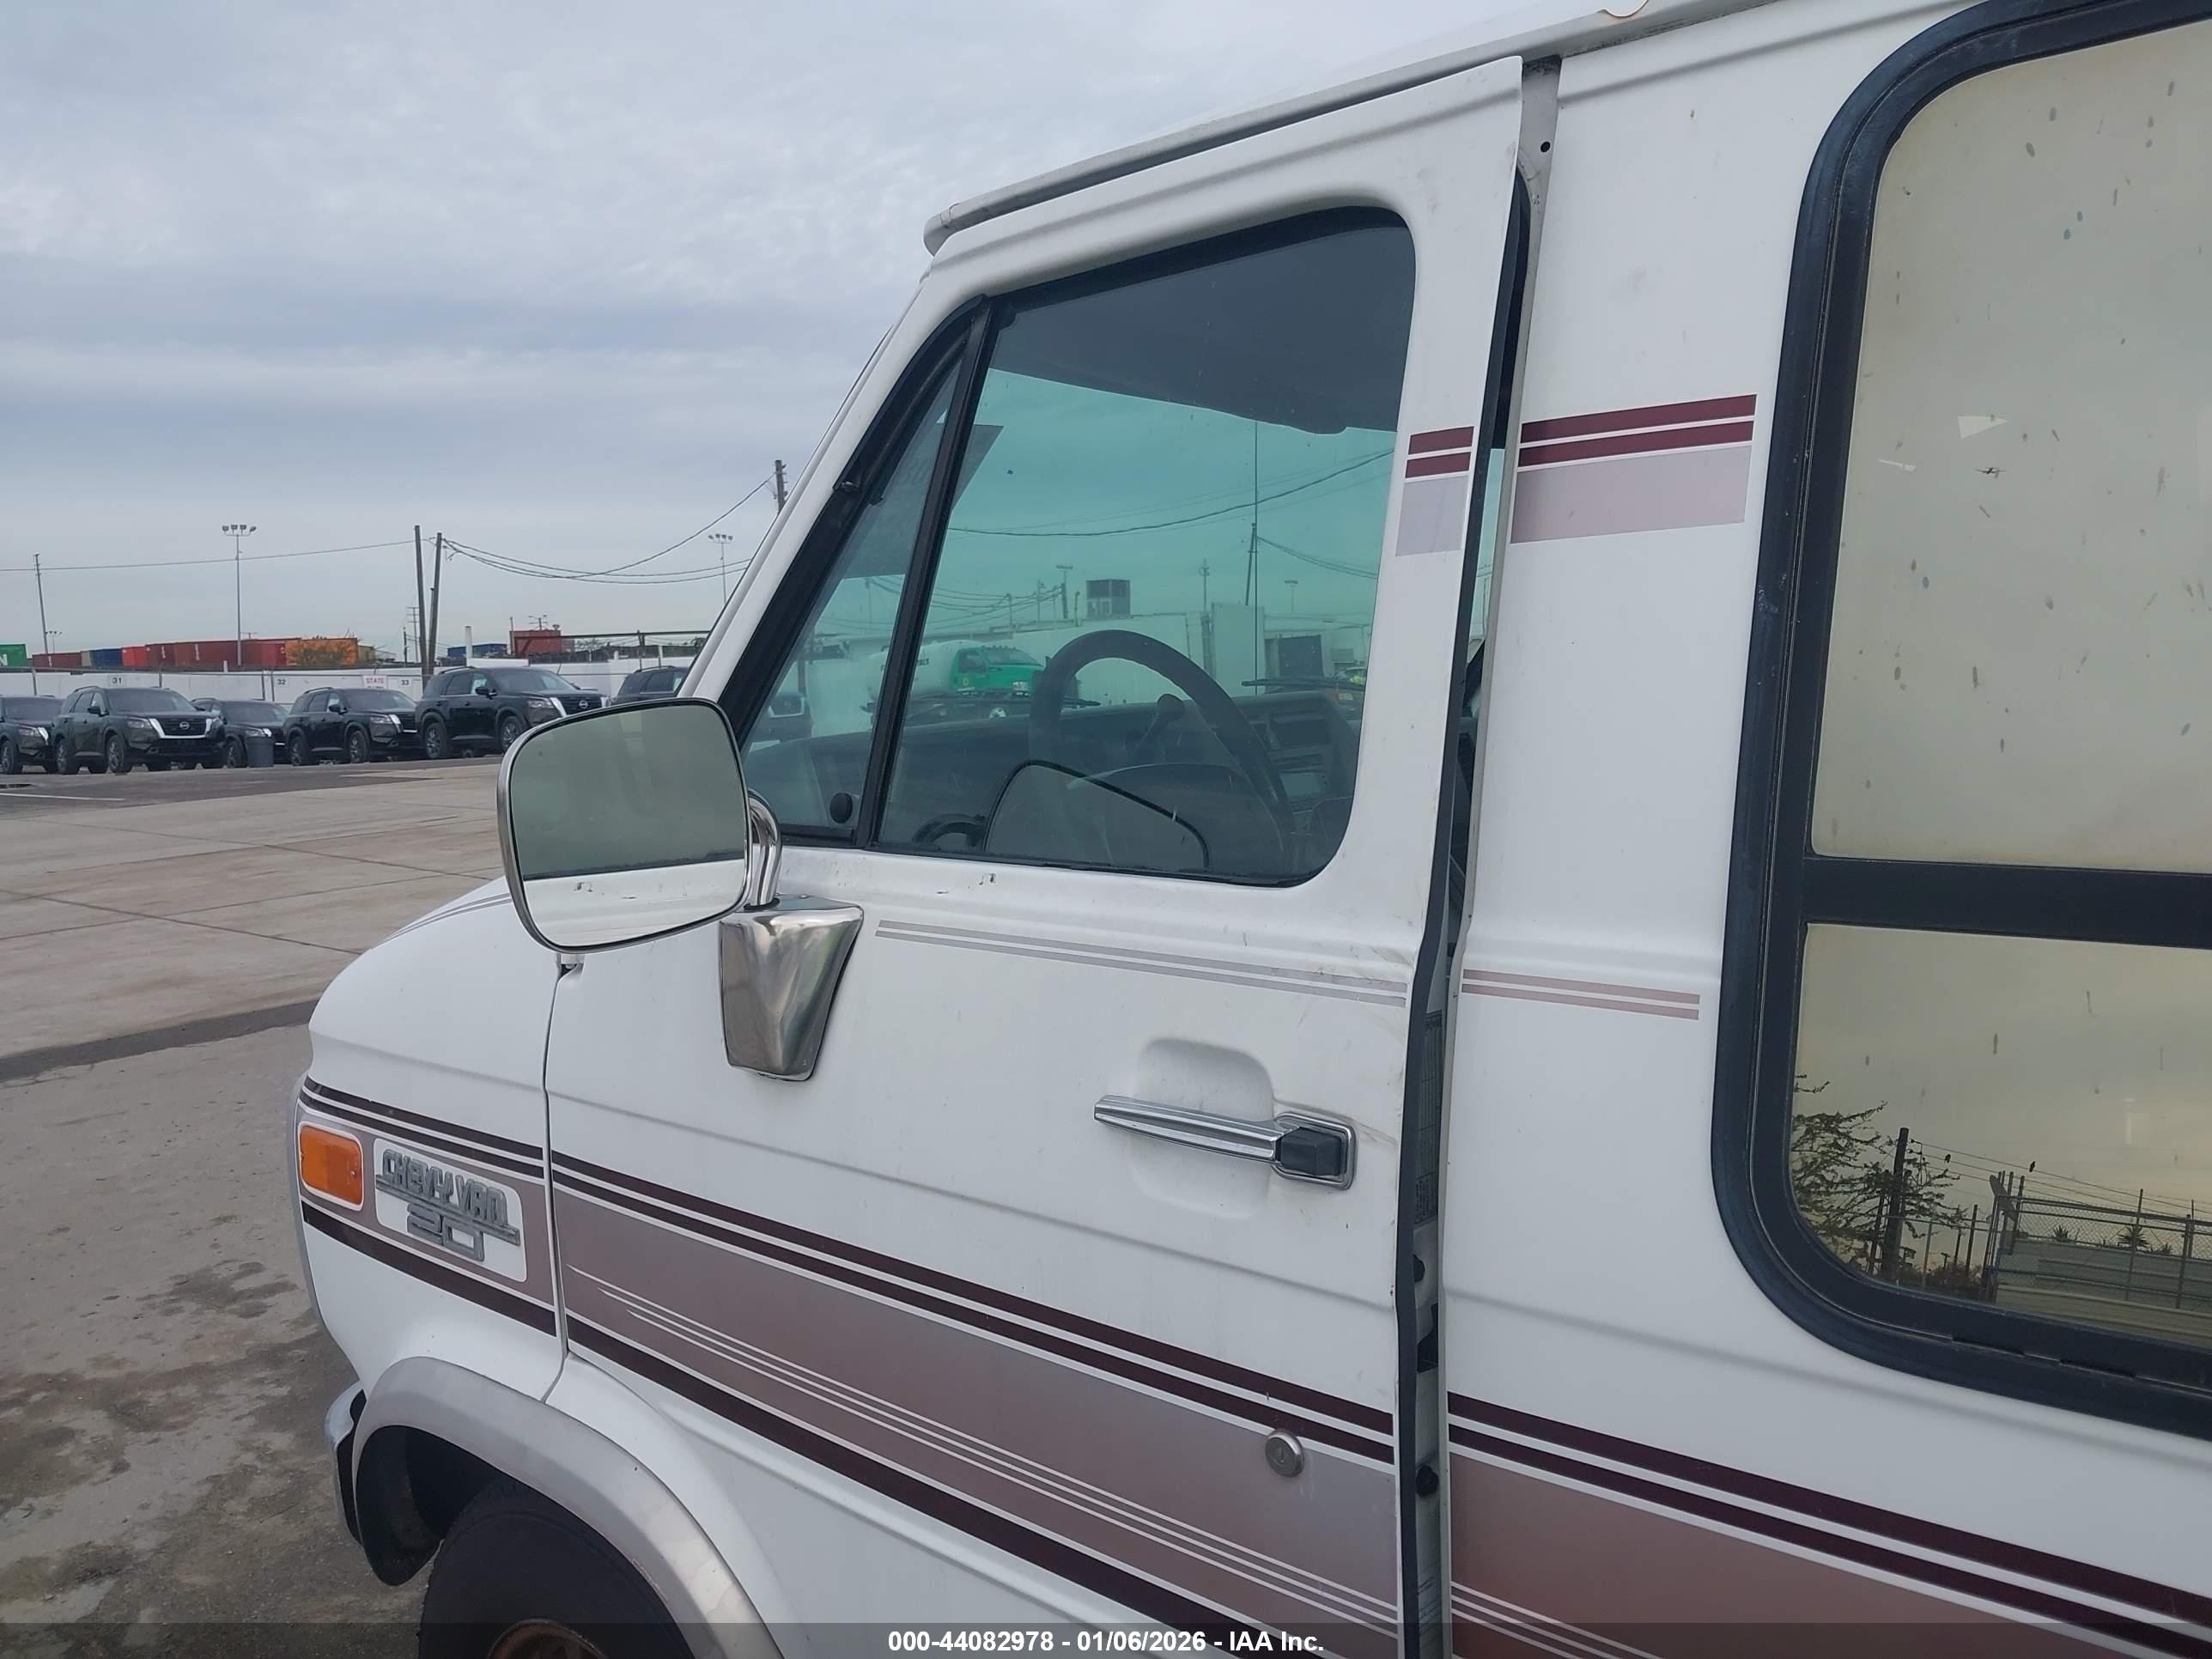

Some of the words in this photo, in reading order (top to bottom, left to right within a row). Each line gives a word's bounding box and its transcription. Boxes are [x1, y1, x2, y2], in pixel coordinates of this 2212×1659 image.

[383, 1149, 453, 1203] CHEVY
[455, 1174, 508, 1227] VAN
[407, 1202, 485, 1262] 20
